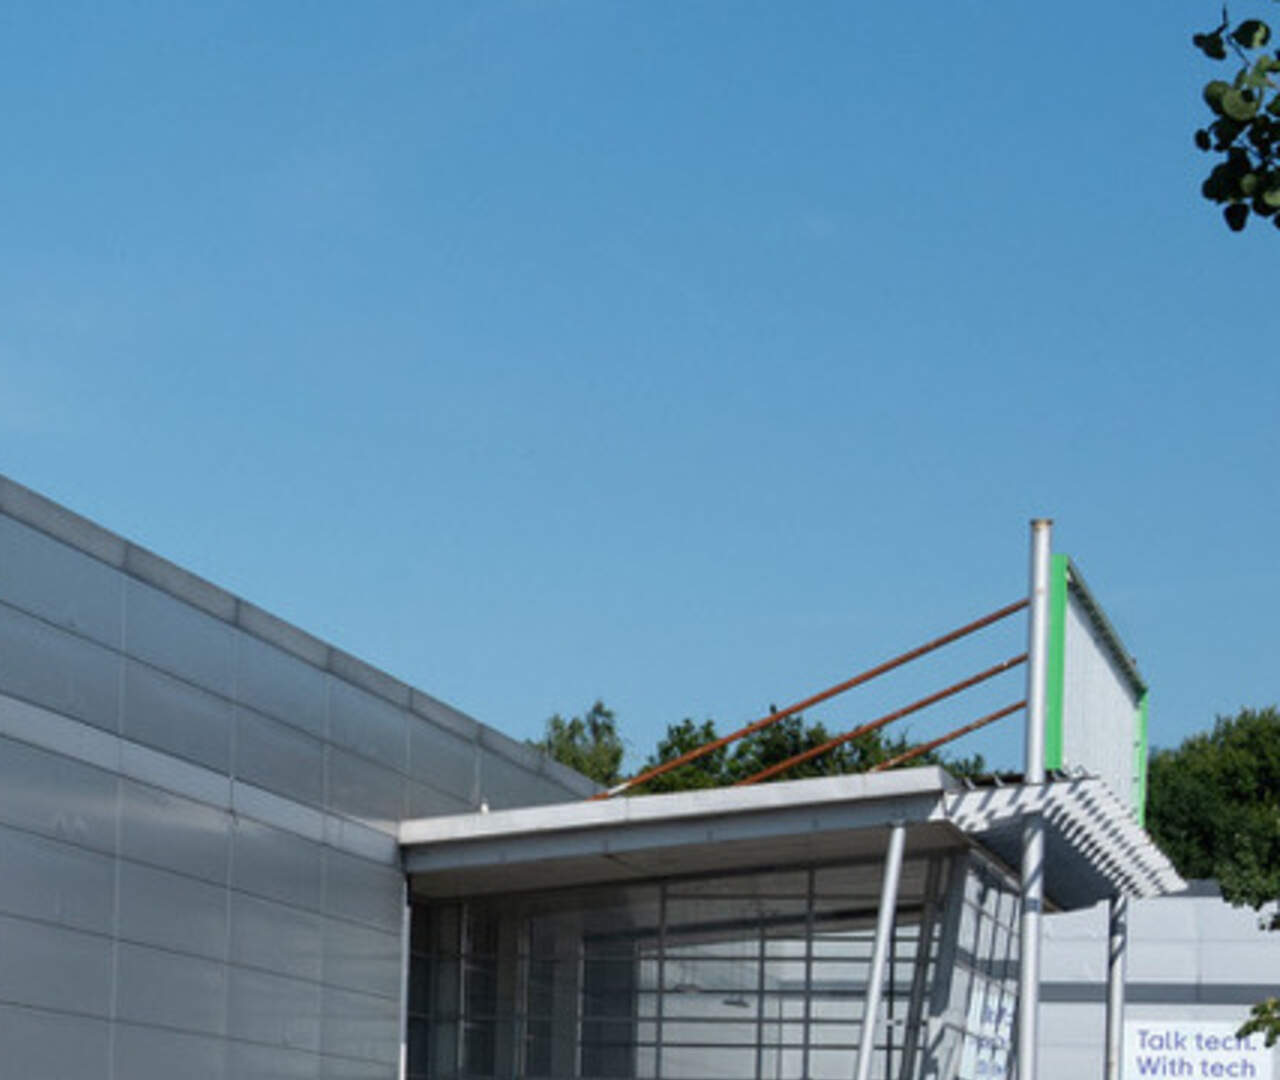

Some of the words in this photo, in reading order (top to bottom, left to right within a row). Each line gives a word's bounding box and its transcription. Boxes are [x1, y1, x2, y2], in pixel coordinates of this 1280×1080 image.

[1138, 1029, 1187, 1051] Talk
[1136, 1056, 1193, 1078] With
[1200, 1057, 1256, 1078] tech
